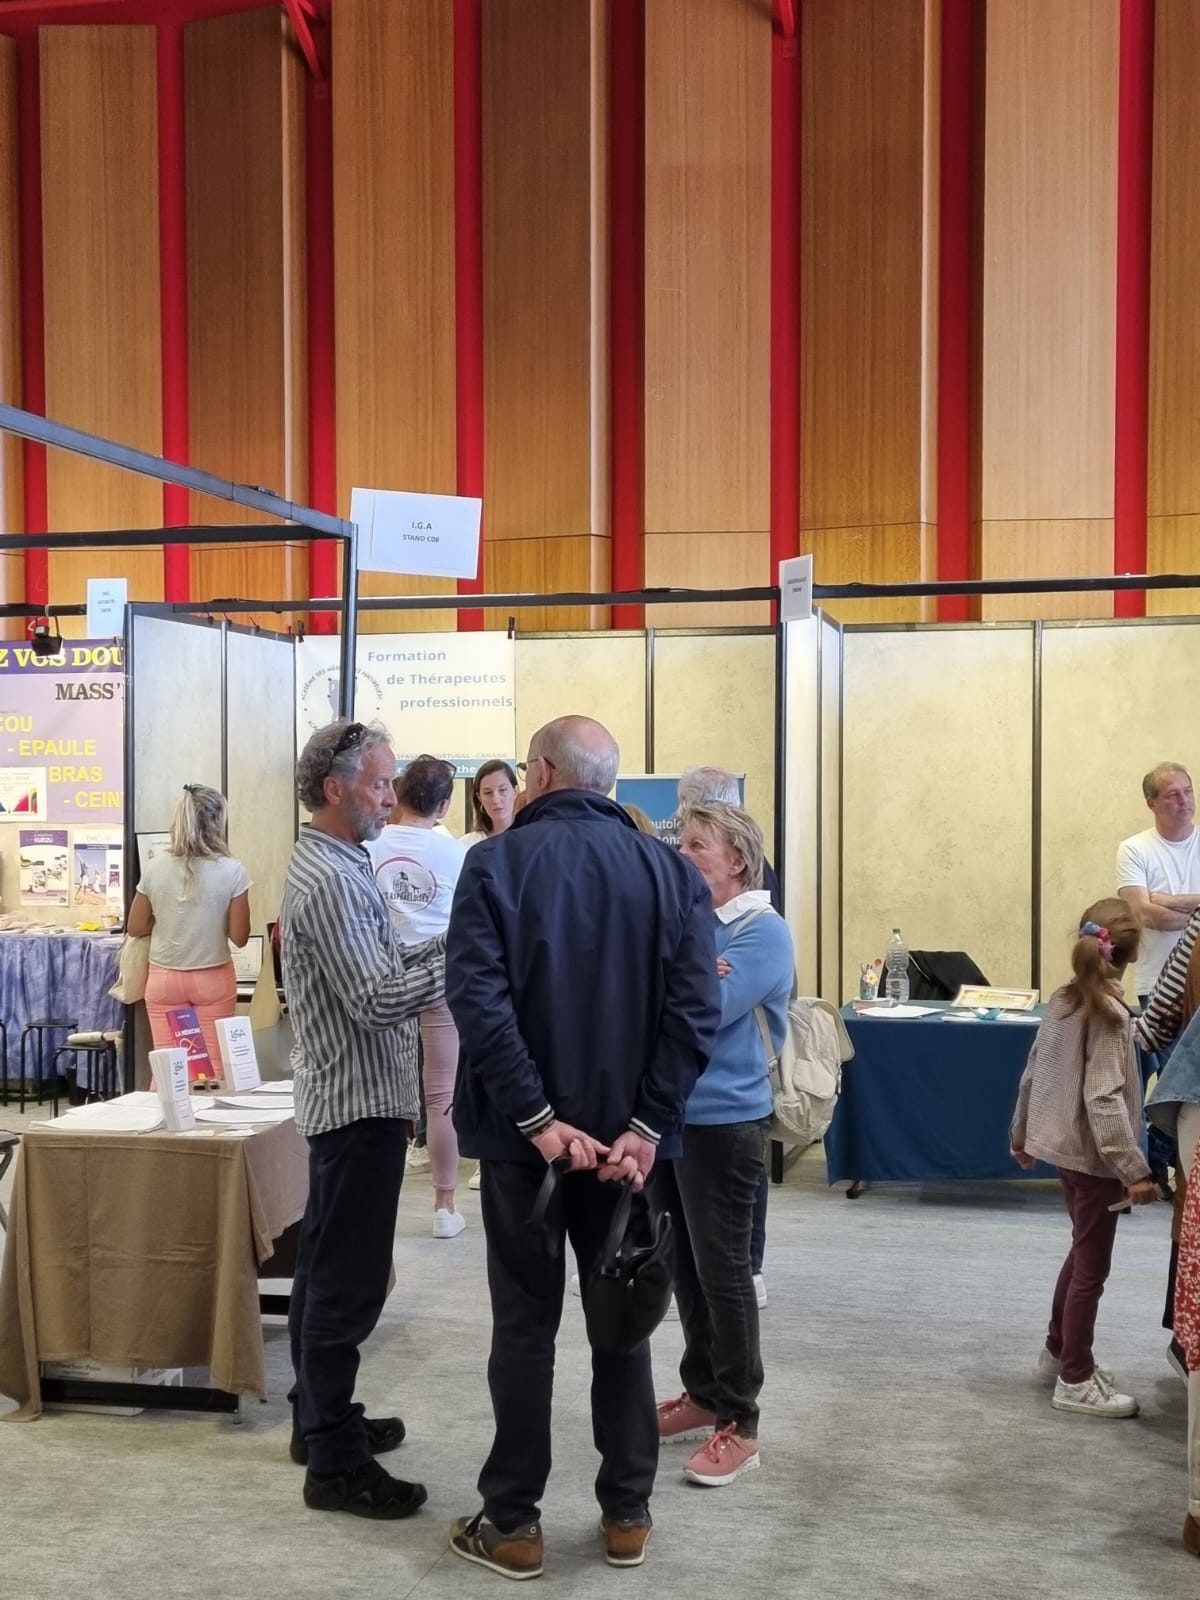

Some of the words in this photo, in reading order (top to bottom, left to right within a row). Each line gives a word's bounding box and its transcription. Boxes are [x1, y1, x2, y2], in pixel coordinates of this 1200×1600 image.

[402, 533, 426, 542] STAND
[367, 650, 447, 662] Formation
[386, 674, 405, 685] de
[409, 673, 507, 686] Thérapeutes
[55, 682, 124, 700] MASS'
[399, 696, 513, 711] professionnels
[18, 738, 97, 757] EPAULE
[48, 765, 104, 783] BRAS
[75, 790, 124, 808] CEIN
